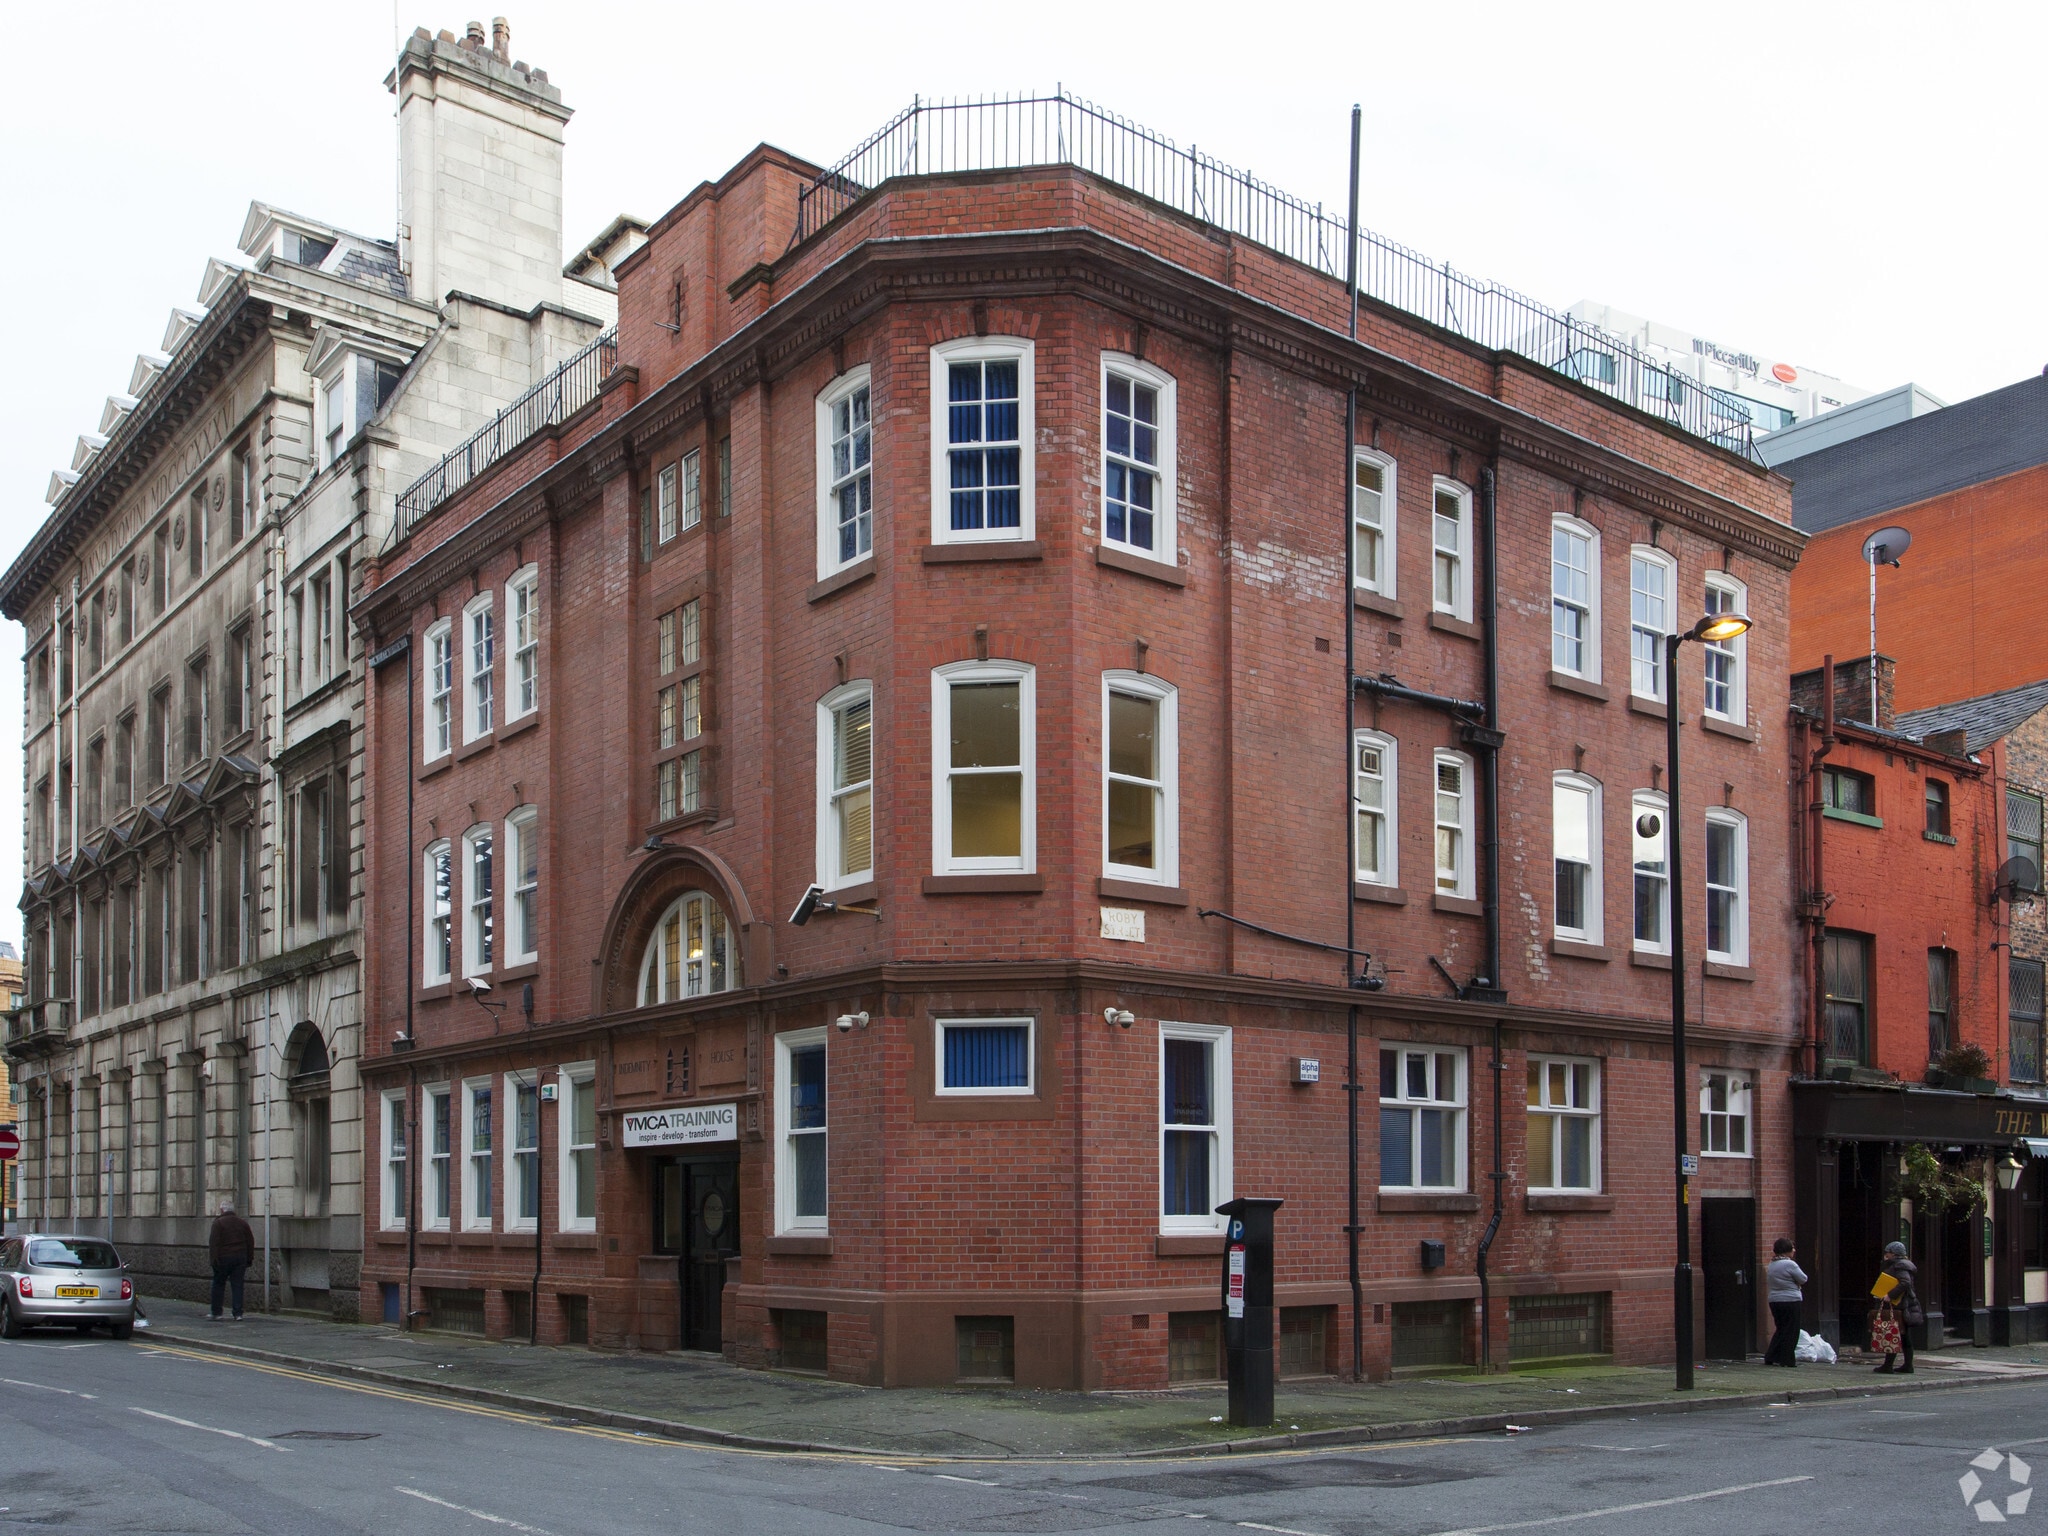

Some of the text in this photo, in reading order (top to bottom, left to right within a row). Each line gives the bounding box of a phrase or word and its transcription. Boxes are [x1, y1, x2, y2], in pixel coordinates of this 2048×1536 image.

[1705, 341, 1760, 376] Piccadilly
[1104, 924, 1140, 938] STRET
[618, 1049, 735, 1075] INDEMNITY HOUSE
[1301, 1061, 1318, 1073] alpha
[625, 1109, 733, 1131] YMCA TRAINING
[1994, 1109, 2033, 1135] THE
[638, 1133, 657, 1143] inspire
[661, 1131, 684, 1141] develop
[688, 1128, 718, 1138] transform
[1233, 1220, 1243, 1239] P
